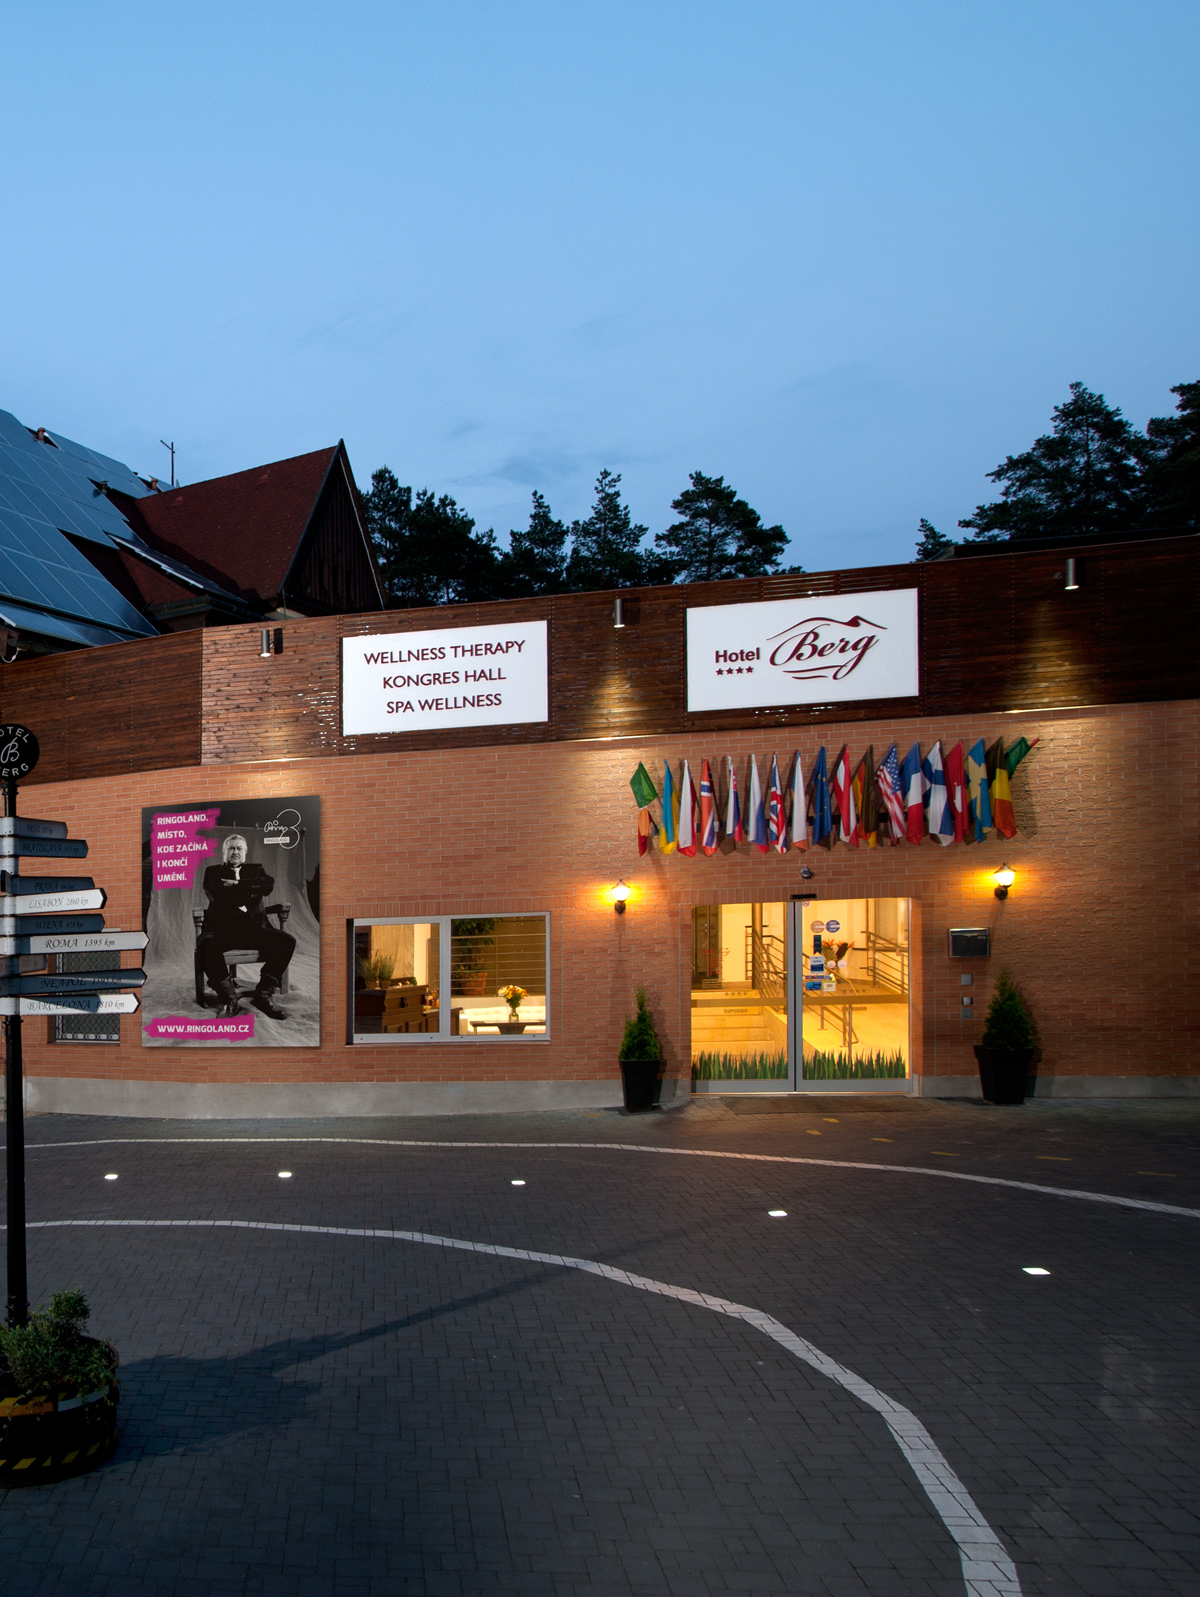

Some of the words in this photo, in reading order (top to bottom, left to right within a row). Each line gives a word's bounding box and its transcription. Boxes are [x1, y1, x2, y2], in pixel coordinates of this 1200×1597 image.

[364, 647, 446, 665] WELLNESS
[450, 639, 526, 658] THERAPY
[714, 647, 761, 663] Hotel
[769, 623, 879, 680] Berg
[383, 671, 460, 689] KONGRES
[464, 667, 507, 683] HALL
[386, 700, 415, 714] SPA
[418, 693, 502, 711] WELLNESS
[157, 813, 209, 825] RINGOLAND.
[157, 829, 187, 840] MÍSTO,
[22, 843, 62, 853] BRATISLAVA
[157, 844, 175, 854] KDE
[176, 841, 208, 852] ZAČÍNÁ
[161, 856, 188, 868] KONČÍ
[157, 871, 187, 882] UMĚNÍ.
[34, 881, 58, 891] PRAHA
[29, 896, 64, 909] LISABON
[80, 896, 88, 906] km
[44, 938, 79, 949] ROMA
[84, 938, 103, 946] 1395
[103, 938, 115, 947] km
[40, 977, 87, 989] NEAPOL
[27, 1000, 91, 1011] BARCELONA
[95, 1000, 113, 1009] 1810
[114, 999, 125, 1009] km
[157, 1024, 250, 1033] WWW.RINGOLAND.CZ
